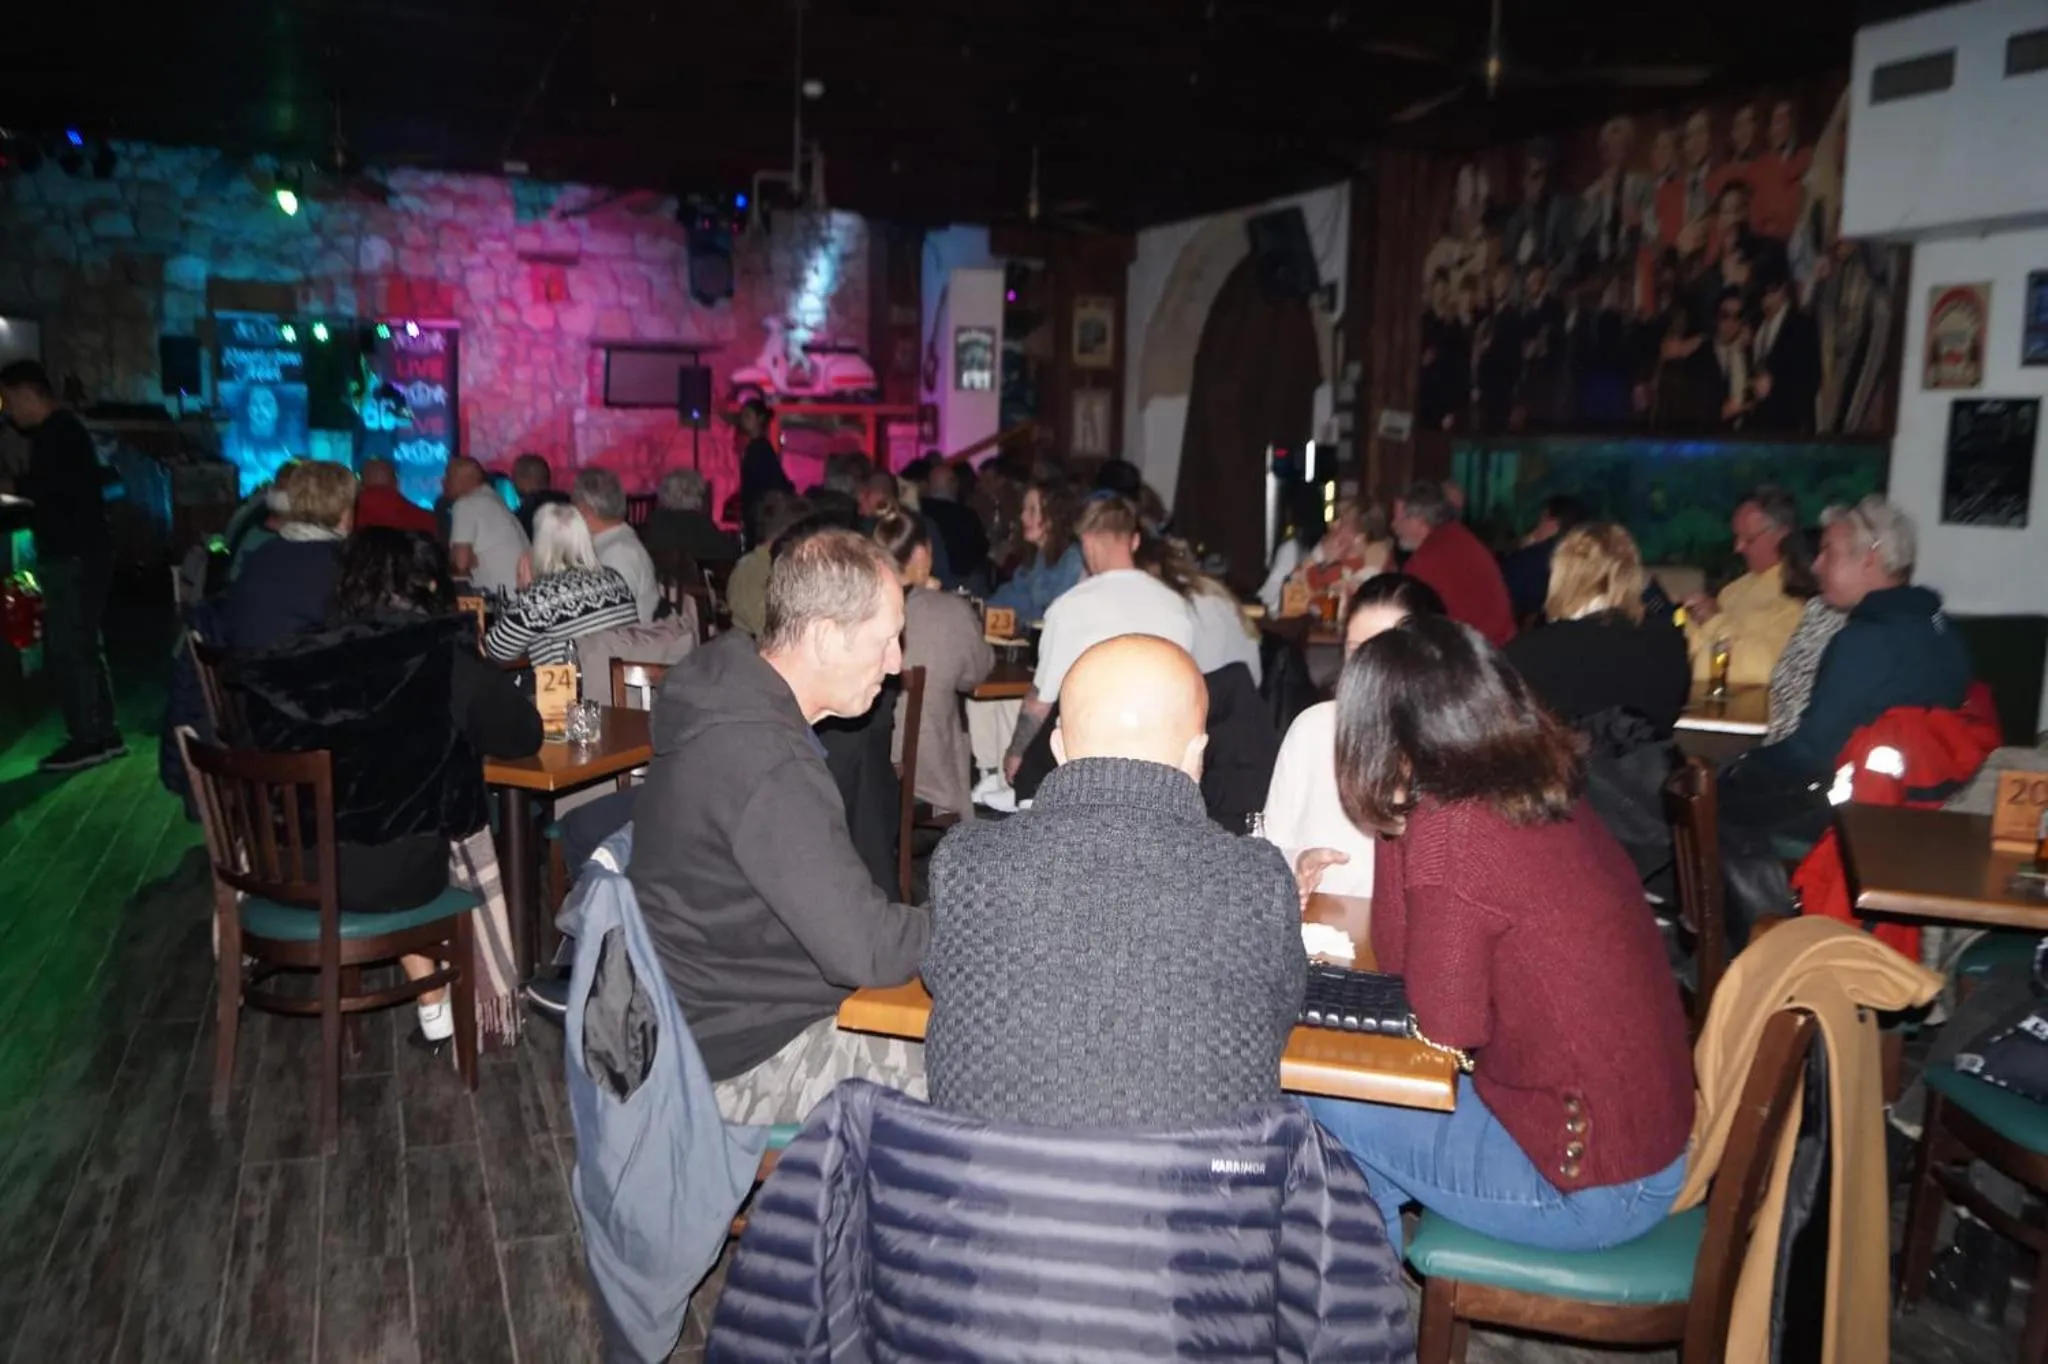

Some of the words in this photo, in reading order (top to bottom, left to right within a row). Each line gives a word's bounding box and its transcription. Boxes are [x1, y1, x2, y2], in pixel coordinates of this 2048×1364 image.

[396, 357, 445, 379] LIVE
[990, 611, 1011, 630] 23
[542, 669, 572, 692] 24
[2006, 778, 2048, 807] 20
